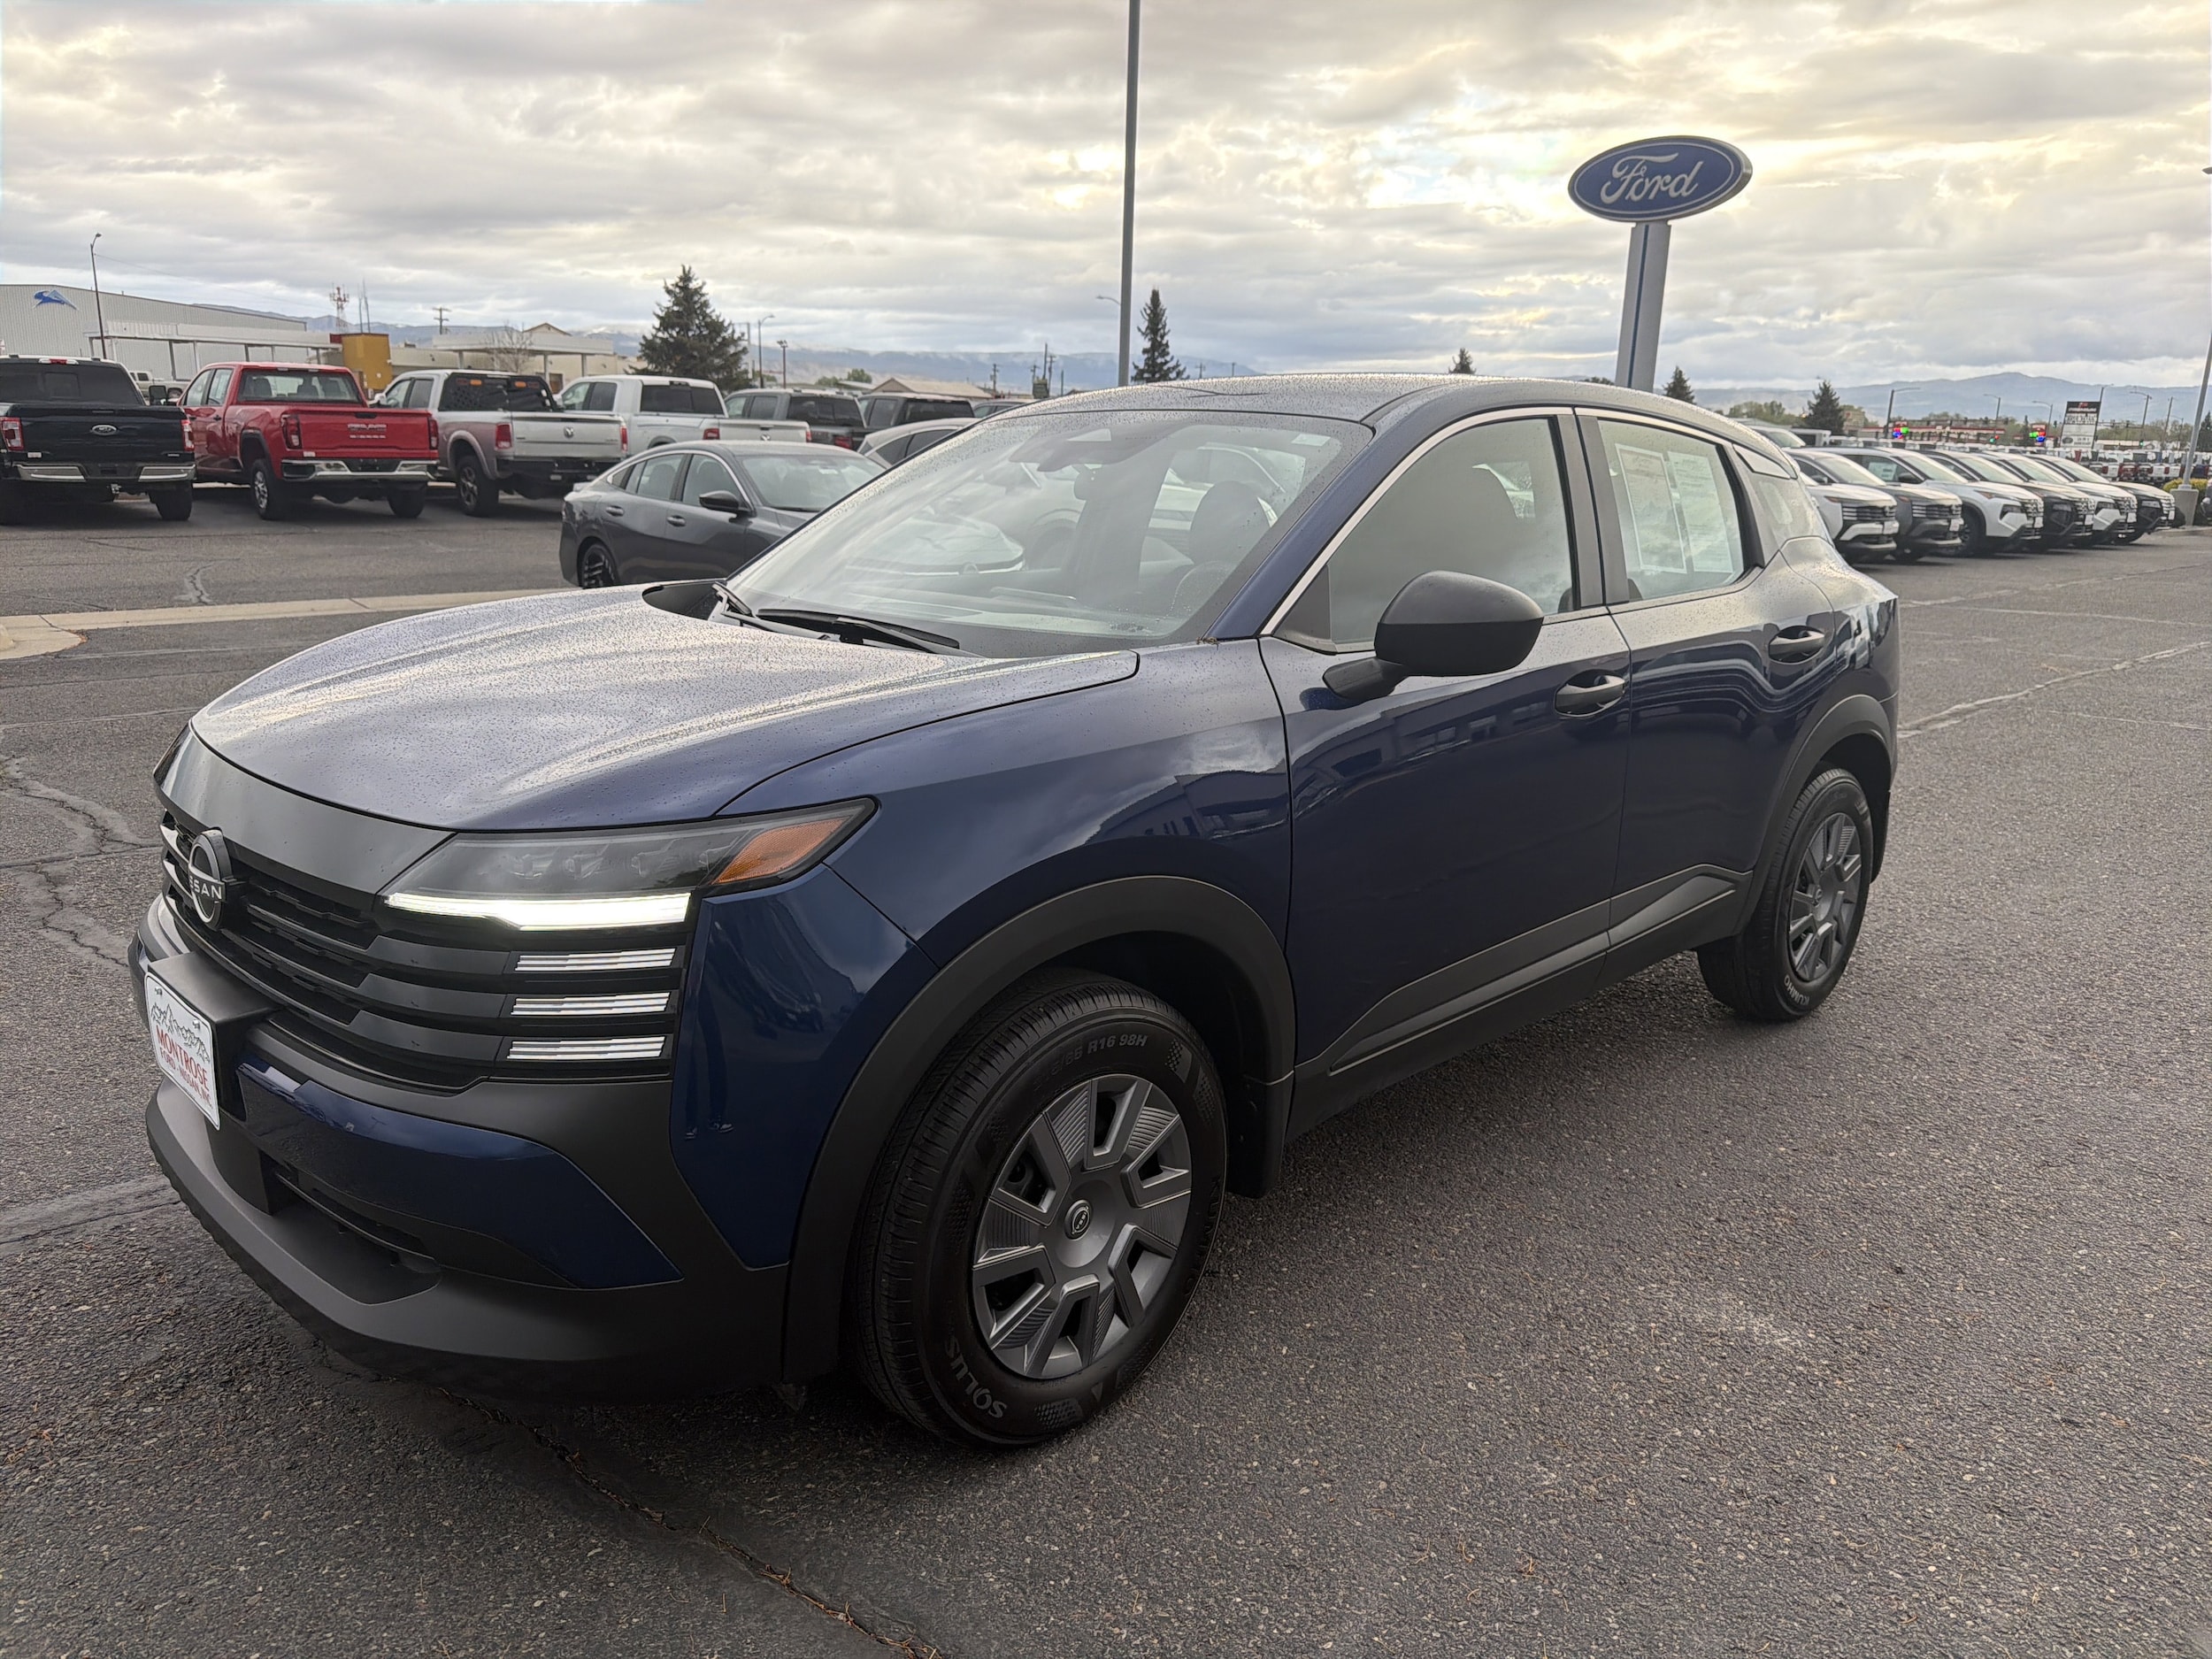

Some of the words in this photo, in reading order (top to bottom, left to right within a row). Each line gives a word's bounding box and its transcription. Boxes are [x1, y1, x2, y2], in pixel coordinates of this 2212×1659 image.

[1601, 152, 1704, 204] Ford
[1784, 974, 1810, 1005] KUMHO
[156, 1024, 211, 1092] MONTROSE
[159, 1047, 177, 1071] FORD
[1087, 1035, 1117, 1055] R16
[1118, 1033, 1149, 1048] 98H
[943, 1334, 1009, 1419] SOLUS
